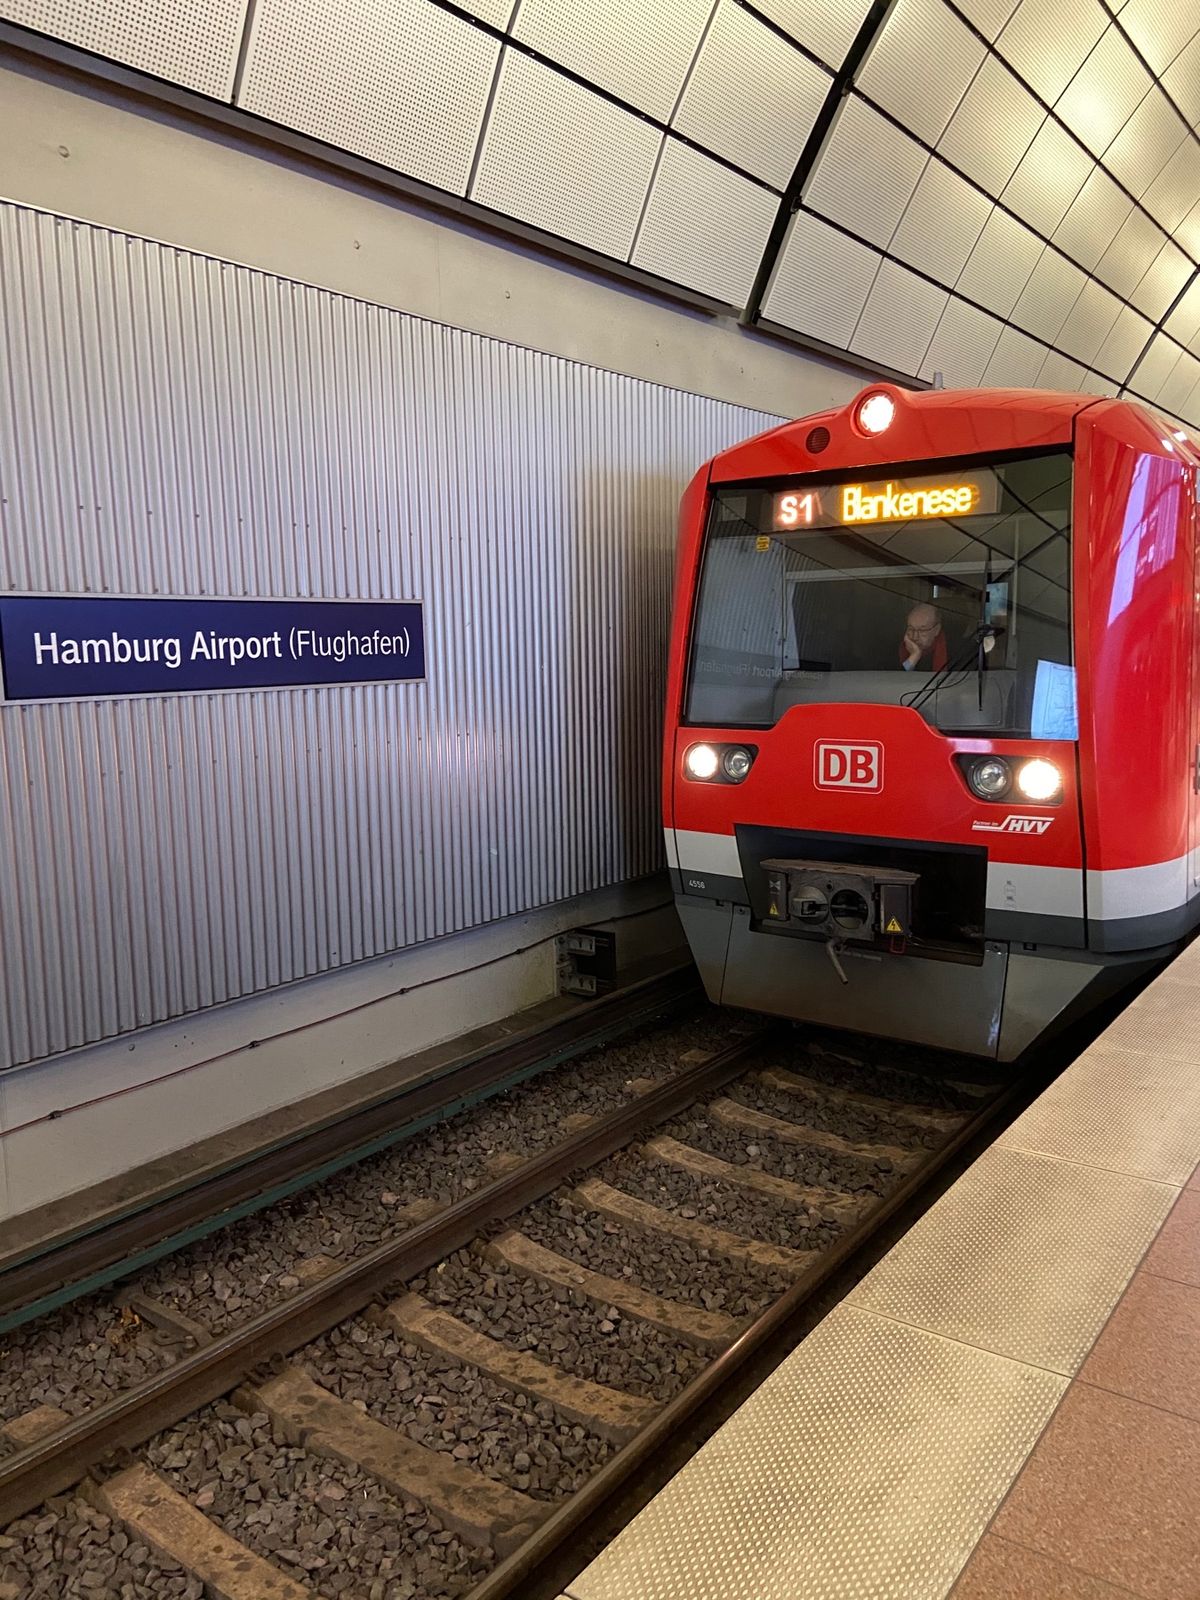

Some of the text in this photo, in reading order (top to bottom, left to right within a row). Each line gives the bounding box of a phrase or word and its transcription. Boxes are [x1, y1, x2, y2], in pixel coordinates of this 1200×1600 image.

[780, 483, 973, 524] S1 Blankenese
[33, 626, 411, 669] Hamburg Airport (Flughafen)
[823, 748, 874, 784] DB
[1007, 819, 1052, 833] HVV
